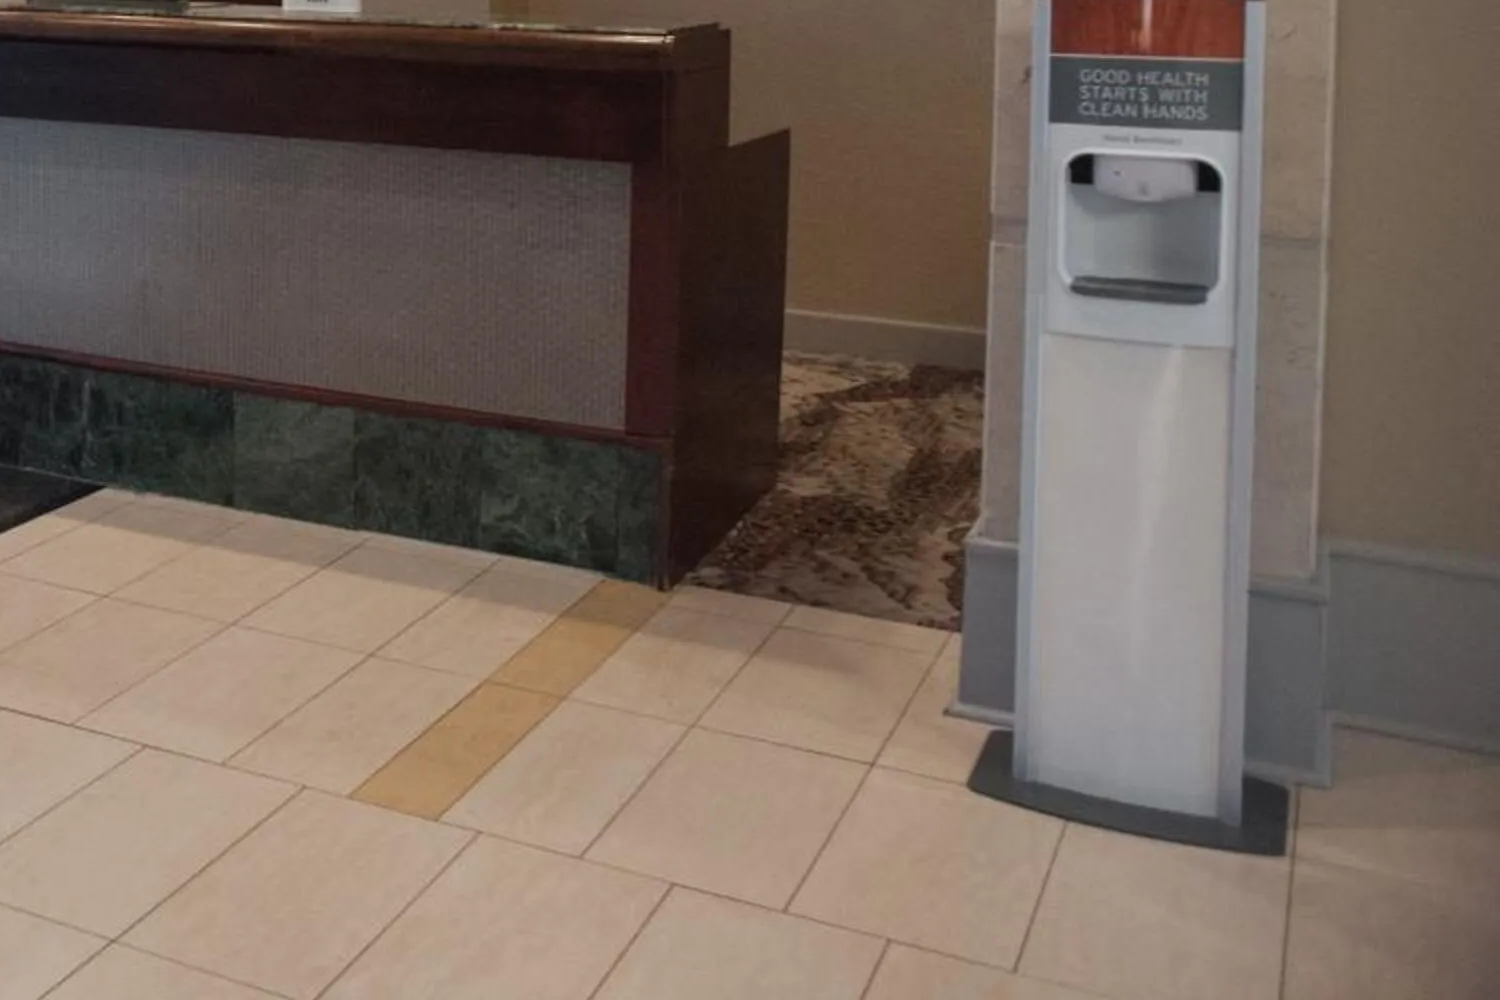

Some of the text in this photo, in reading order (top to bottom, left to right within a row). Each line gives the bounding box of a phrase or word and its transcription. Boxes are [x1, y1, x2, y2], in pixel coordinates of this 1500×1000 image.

[1079, 68, 1210, 87] GOOD HEALTH
[1078, 85, 1209, 104] STARTS WITH
[1077, 101, 1210, 121] CLEAN HANDS
